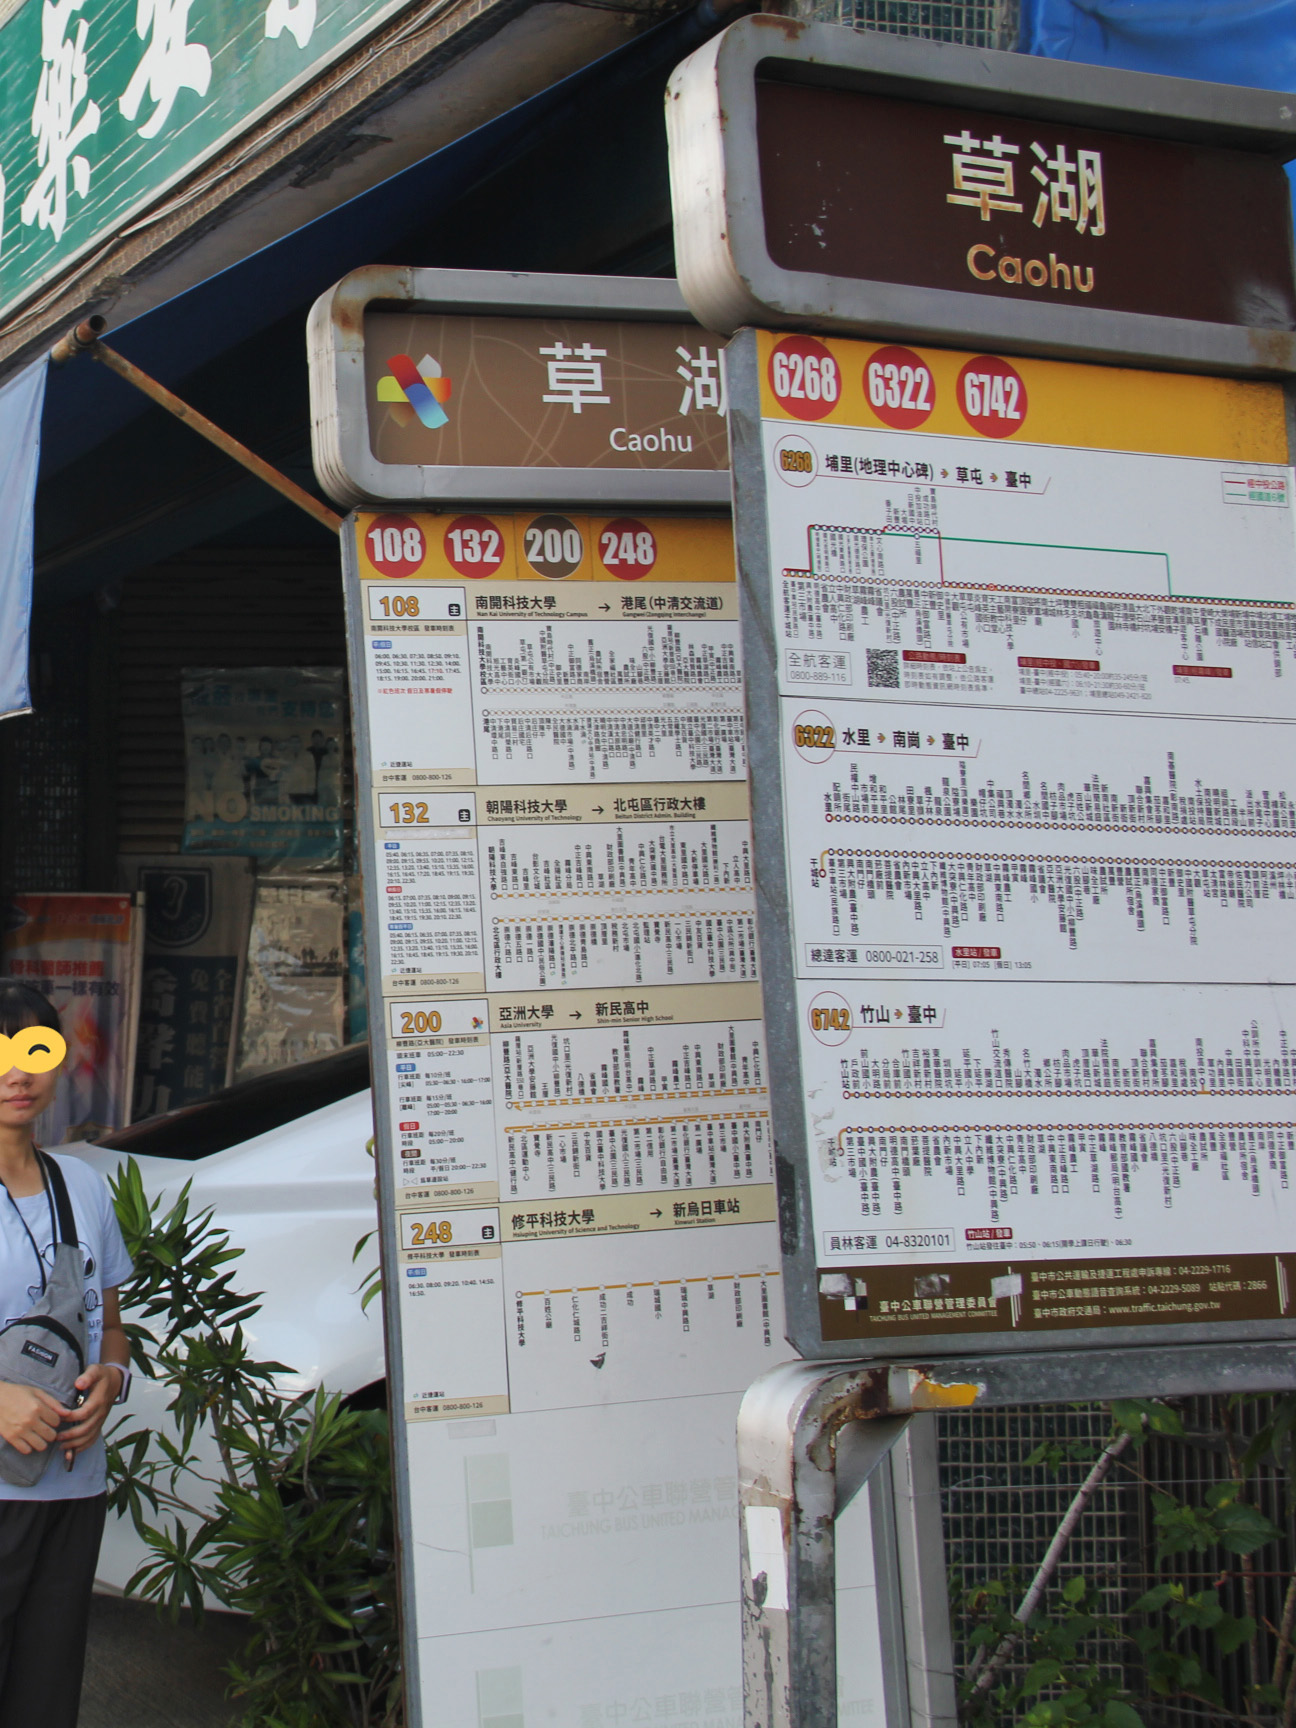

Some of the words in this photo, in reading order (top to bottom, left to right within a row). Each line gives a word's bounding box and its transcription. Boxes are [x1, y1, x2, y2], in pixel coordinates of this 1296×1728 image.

[943, 130, 1106, 236] 草湖
[966, 243, 1094, 292] Caohu
[773, 352, 837, 403] 6268
[868, 362, 931, 411] 6322
[965, 372, 1020, 420] 6742
[609, 427, 692, 452] Caohu
[780, 449, 813, 473] 6268
[955, 466, 983, 485] 草屯
[1005, 470, 1032, 489] 臺中
[368, 527, 422, 562] 108
[448, 529, 500, 563] 132
[526, 528, 582, 563] 200
[601, 531, 654, 565] 248
[379, 596, 420, 617] 108
[475, 595, 557, 610] 南開科技大學
[621, 596, 723, 611] 港尾(中清交流道)
[788, 652, 847, 670] 全航客運
[790, 670, 847, 683] 0800-889-116
[795, 725, 835, 749] 6322
[842, 728, 871, 747] 水里
[893, 730, 920, 749] 南崗
[942, 733, 969, 751] 臺中
[187, 791, 247, 823] NO
[250, 806, 340, 823] SMOKING
[389, 802, 430, 823] 132
[486, 799, 567, 814] 朝陽科技大學
[613, 797, 707, 812] 北屯區行政大樓
[811, 949, 858, 963] 總達客運
[866, 950, 939, 963] 0800-021-258
[499, 1005, 554, 1021] 亞洲大學
[595, 1000, 649, 1016] 新民高中
[811, 1009, 850, 1030] 6742
[860, 1005, 890, 1023] 竹山
[907, 1005, 937, 1023] 臺中
[401, 1011, 442, 1034] 200
[434, 1188, 474, 1196] 0800-800-126
[512, 1209, 595, 1230] 修平科技大學
[673, 1198, 740, 1218] 新烏日車站
[411, 1221, 453, 1245] 248
[539, 1228, 567, 1237] University
[609, 1223, 640, 1231] Technology
[830, 1236, 878, 1250] 員林客運
[886, 1234, 950, 1248] 04-8320101
[910, 1313, 930, 1321] UNITED
[932, 1311, 966, 1320] MANAGEMENT
[442, 1402, 483, 1411] 0800-800-126
